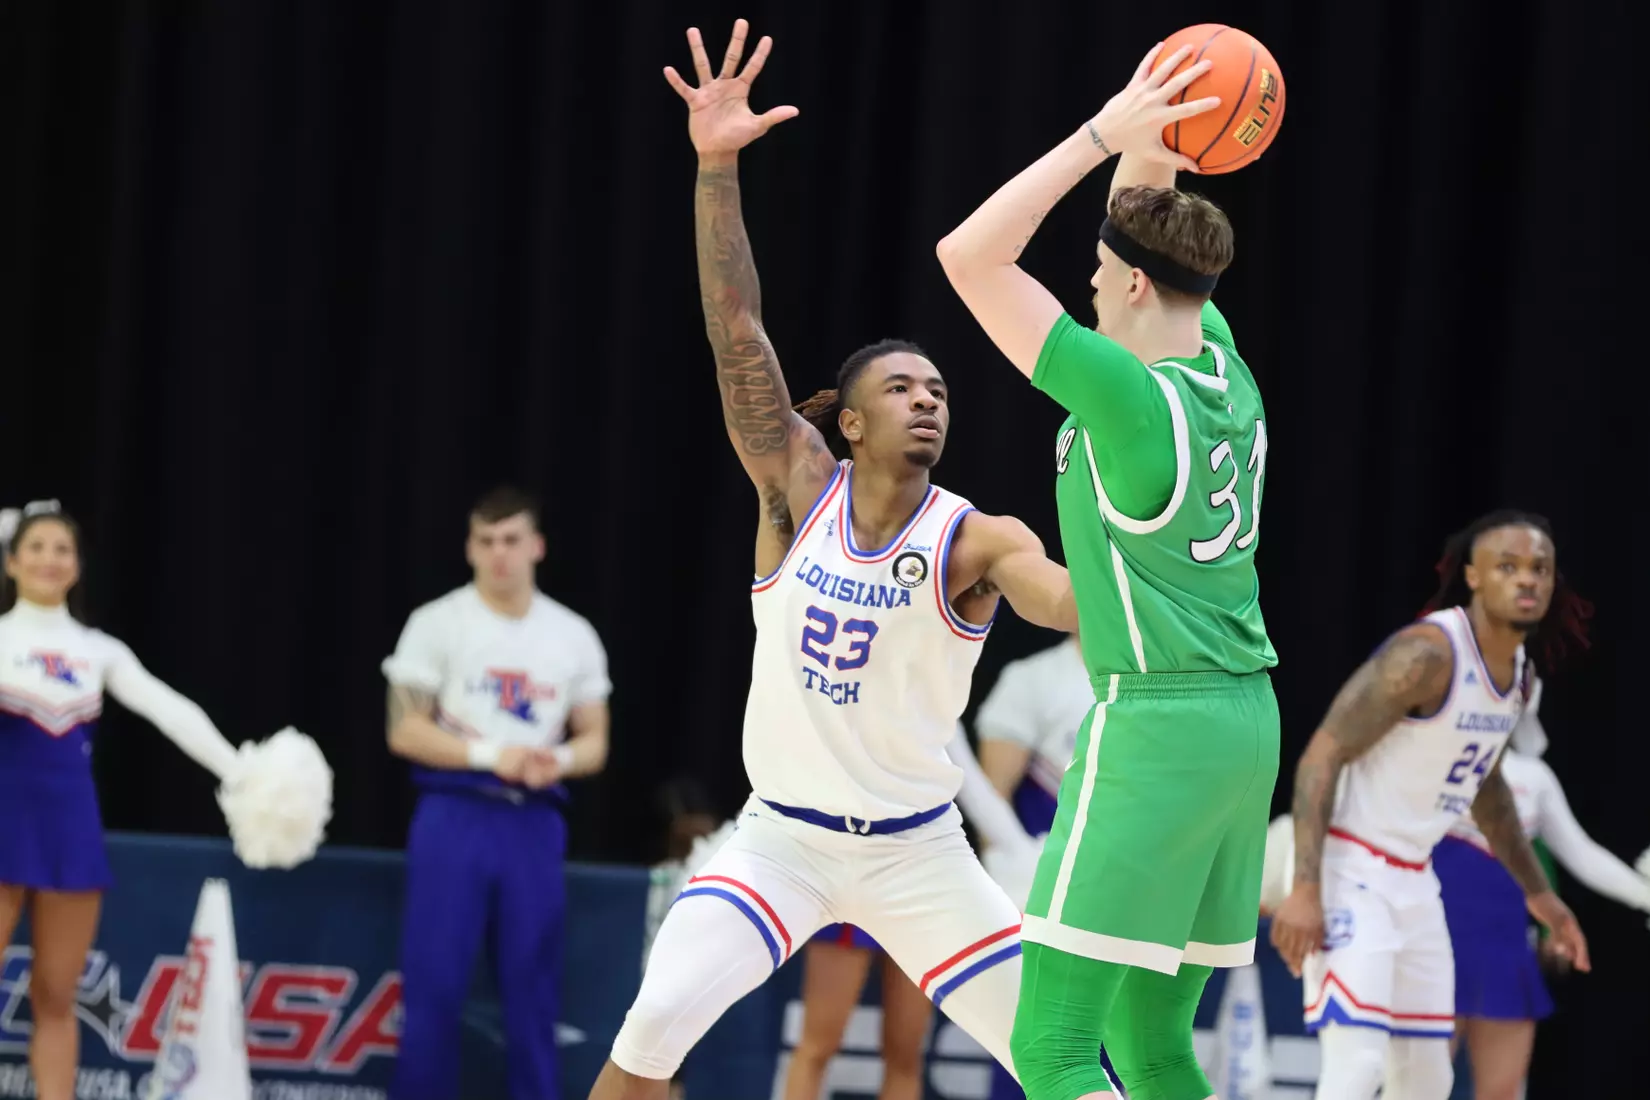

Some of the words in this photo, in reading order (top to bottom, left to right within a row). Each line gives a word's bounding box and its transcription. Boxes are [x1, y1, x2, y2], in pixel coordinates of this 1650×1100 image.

[1189, 418, 1268, 563] 31
[795, 556, 912, 609] LOUISIANA
[800, 604, 879, 671] 23
[802, 666, 860, 706] TECH
[1445, 742, 1497, 790] 24
